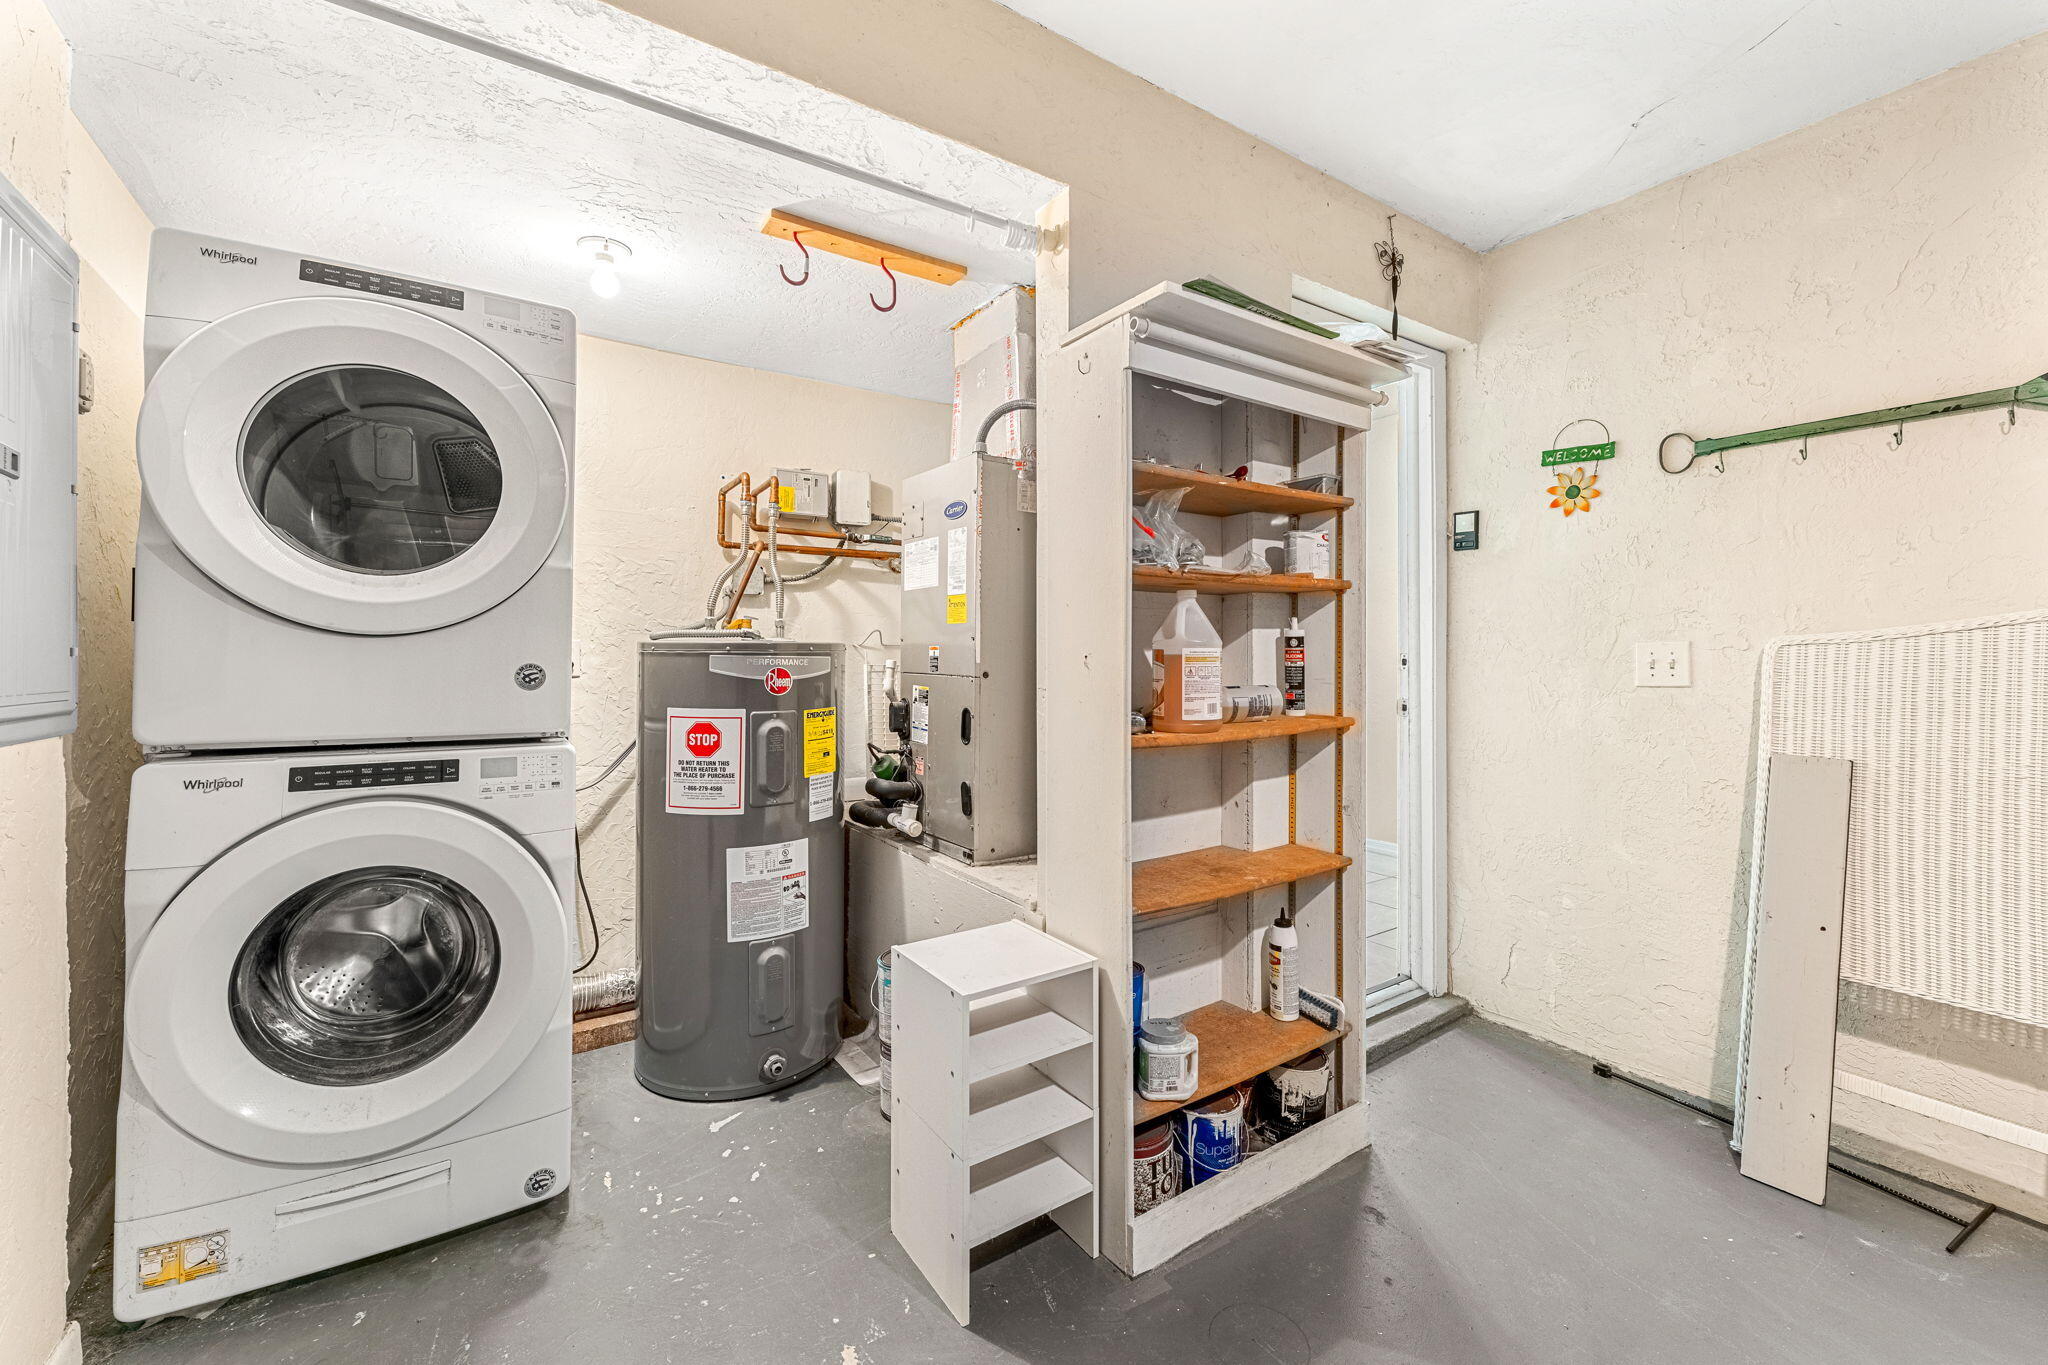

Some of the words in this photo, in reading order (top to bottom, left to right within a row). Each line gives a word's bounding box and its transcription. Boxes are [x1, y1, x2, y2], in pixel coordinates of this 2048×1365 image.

[199, 246, 257, 265] Whirlpool
[1544, 445, 1611, 463] WELCOME
[947, 503, 964, 515] Carrier
[746, 658, 809, 666] PERFORMANCE
[767, 668, 792, 691] Rheem
[688, 733, 718, 746] STOP
[183, 777, 243, 793] Whirlpool
